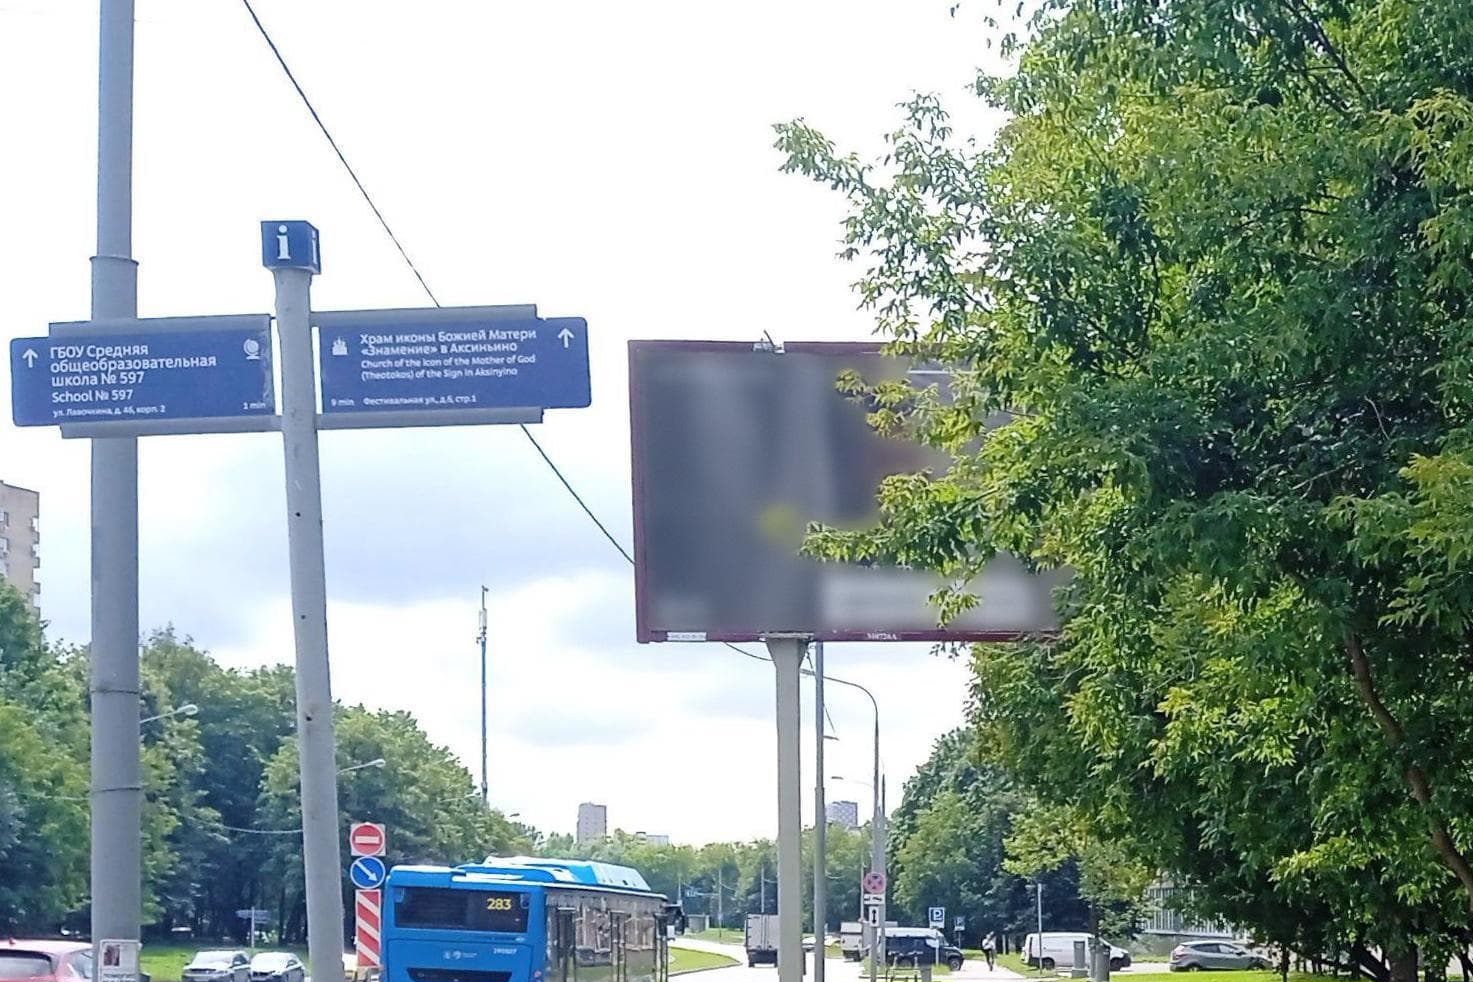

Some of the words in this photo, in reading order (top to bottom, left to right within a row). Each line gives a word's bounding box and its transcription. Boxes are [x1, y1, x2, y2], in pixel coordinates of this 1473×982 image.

[360, 334, 393, 348] Храм
[395, 332, 435, 344] иконы
[438, 329, 487, 342] Божией
[489, 329, 537, 343] Матери
[50, 346, 85, 359] ГБОУ
[86, 345, 149, 360] Средняя
[360, 345, 438, 357] «Знамение»
[440, 345, 448, 354] в
[449, 342, 518, 354] Аксиньино
[50, 356, 217, 375] общеобразовательная
[361, 358, 393, 369] Church
[394, 357, 404, 367] of
[405, 356, 421, 367] the
[443, 356, 453, 366] of
[454, 355, 470, 366] the
[471, 355, 504, 366] Mother
[506, 354, 516, 364] of
[517, 354, 536, 364] God
[52, 374, 98, 387] школа
[101, 372, 117, 385] №
[120, 371, 145, 384] 597
[361, 369, 414, 381] (Theotokos)
[415, 368, 425, 379] of
[426, 368, 442, 379] the
[443, 368, 463, 380] Sign
[475, 366, 518, 379] Aksinyino
[52, 390, 93, 403] School
[95, 390, 109, 401] №
[111, 389, 133, 400] 597
[338, 398, 355, 406] min
[160, 404, 166, 413] 2
[250, 401, 266, 410] min
[486, 898, 512, 910] 283
